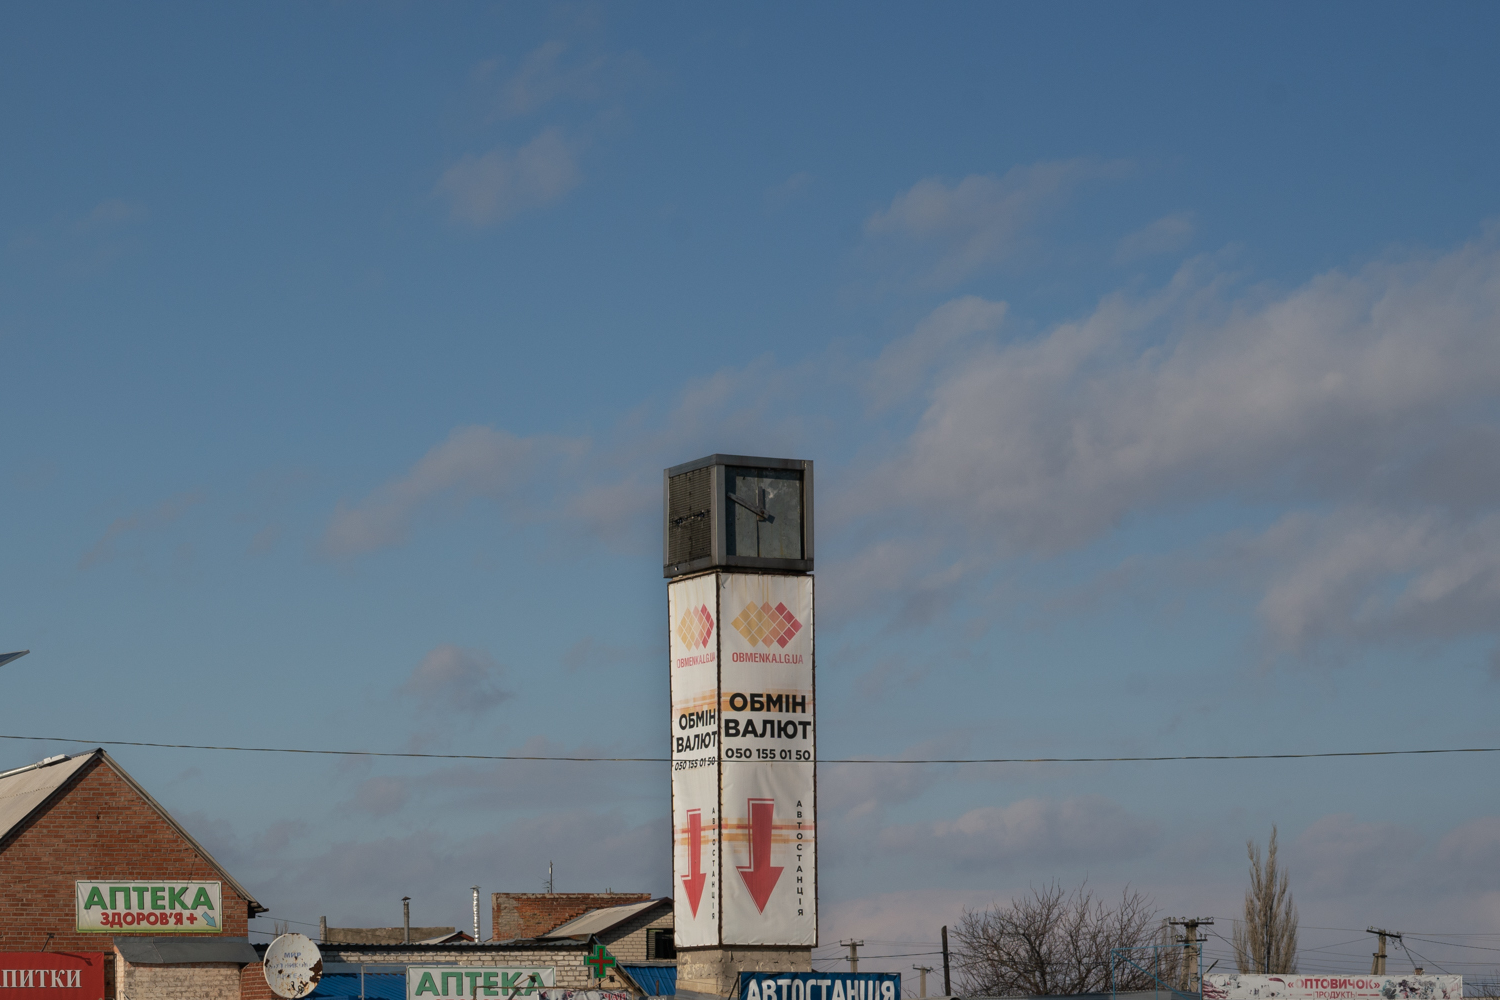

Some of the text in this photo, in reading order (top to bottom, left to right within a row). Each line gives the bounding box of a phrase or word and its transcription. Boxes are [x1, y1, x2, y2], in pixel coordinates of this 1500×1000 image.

[731, 652, 804, 664] OBMENKA.LG.UA
[729, 692, 806, 714] ОБМІН
[678, 708, 716, 731] ОБМІН
[724, 718, 812, 740] ВАЛЮТ
[676, 731, 718, 754] ВАЛЮТ
[725, 748, 811, 761] 050 155 01 50
[83, 886, 215, 911] АПТЕКА
[415, 971, 545, 996] АПТЕКА
